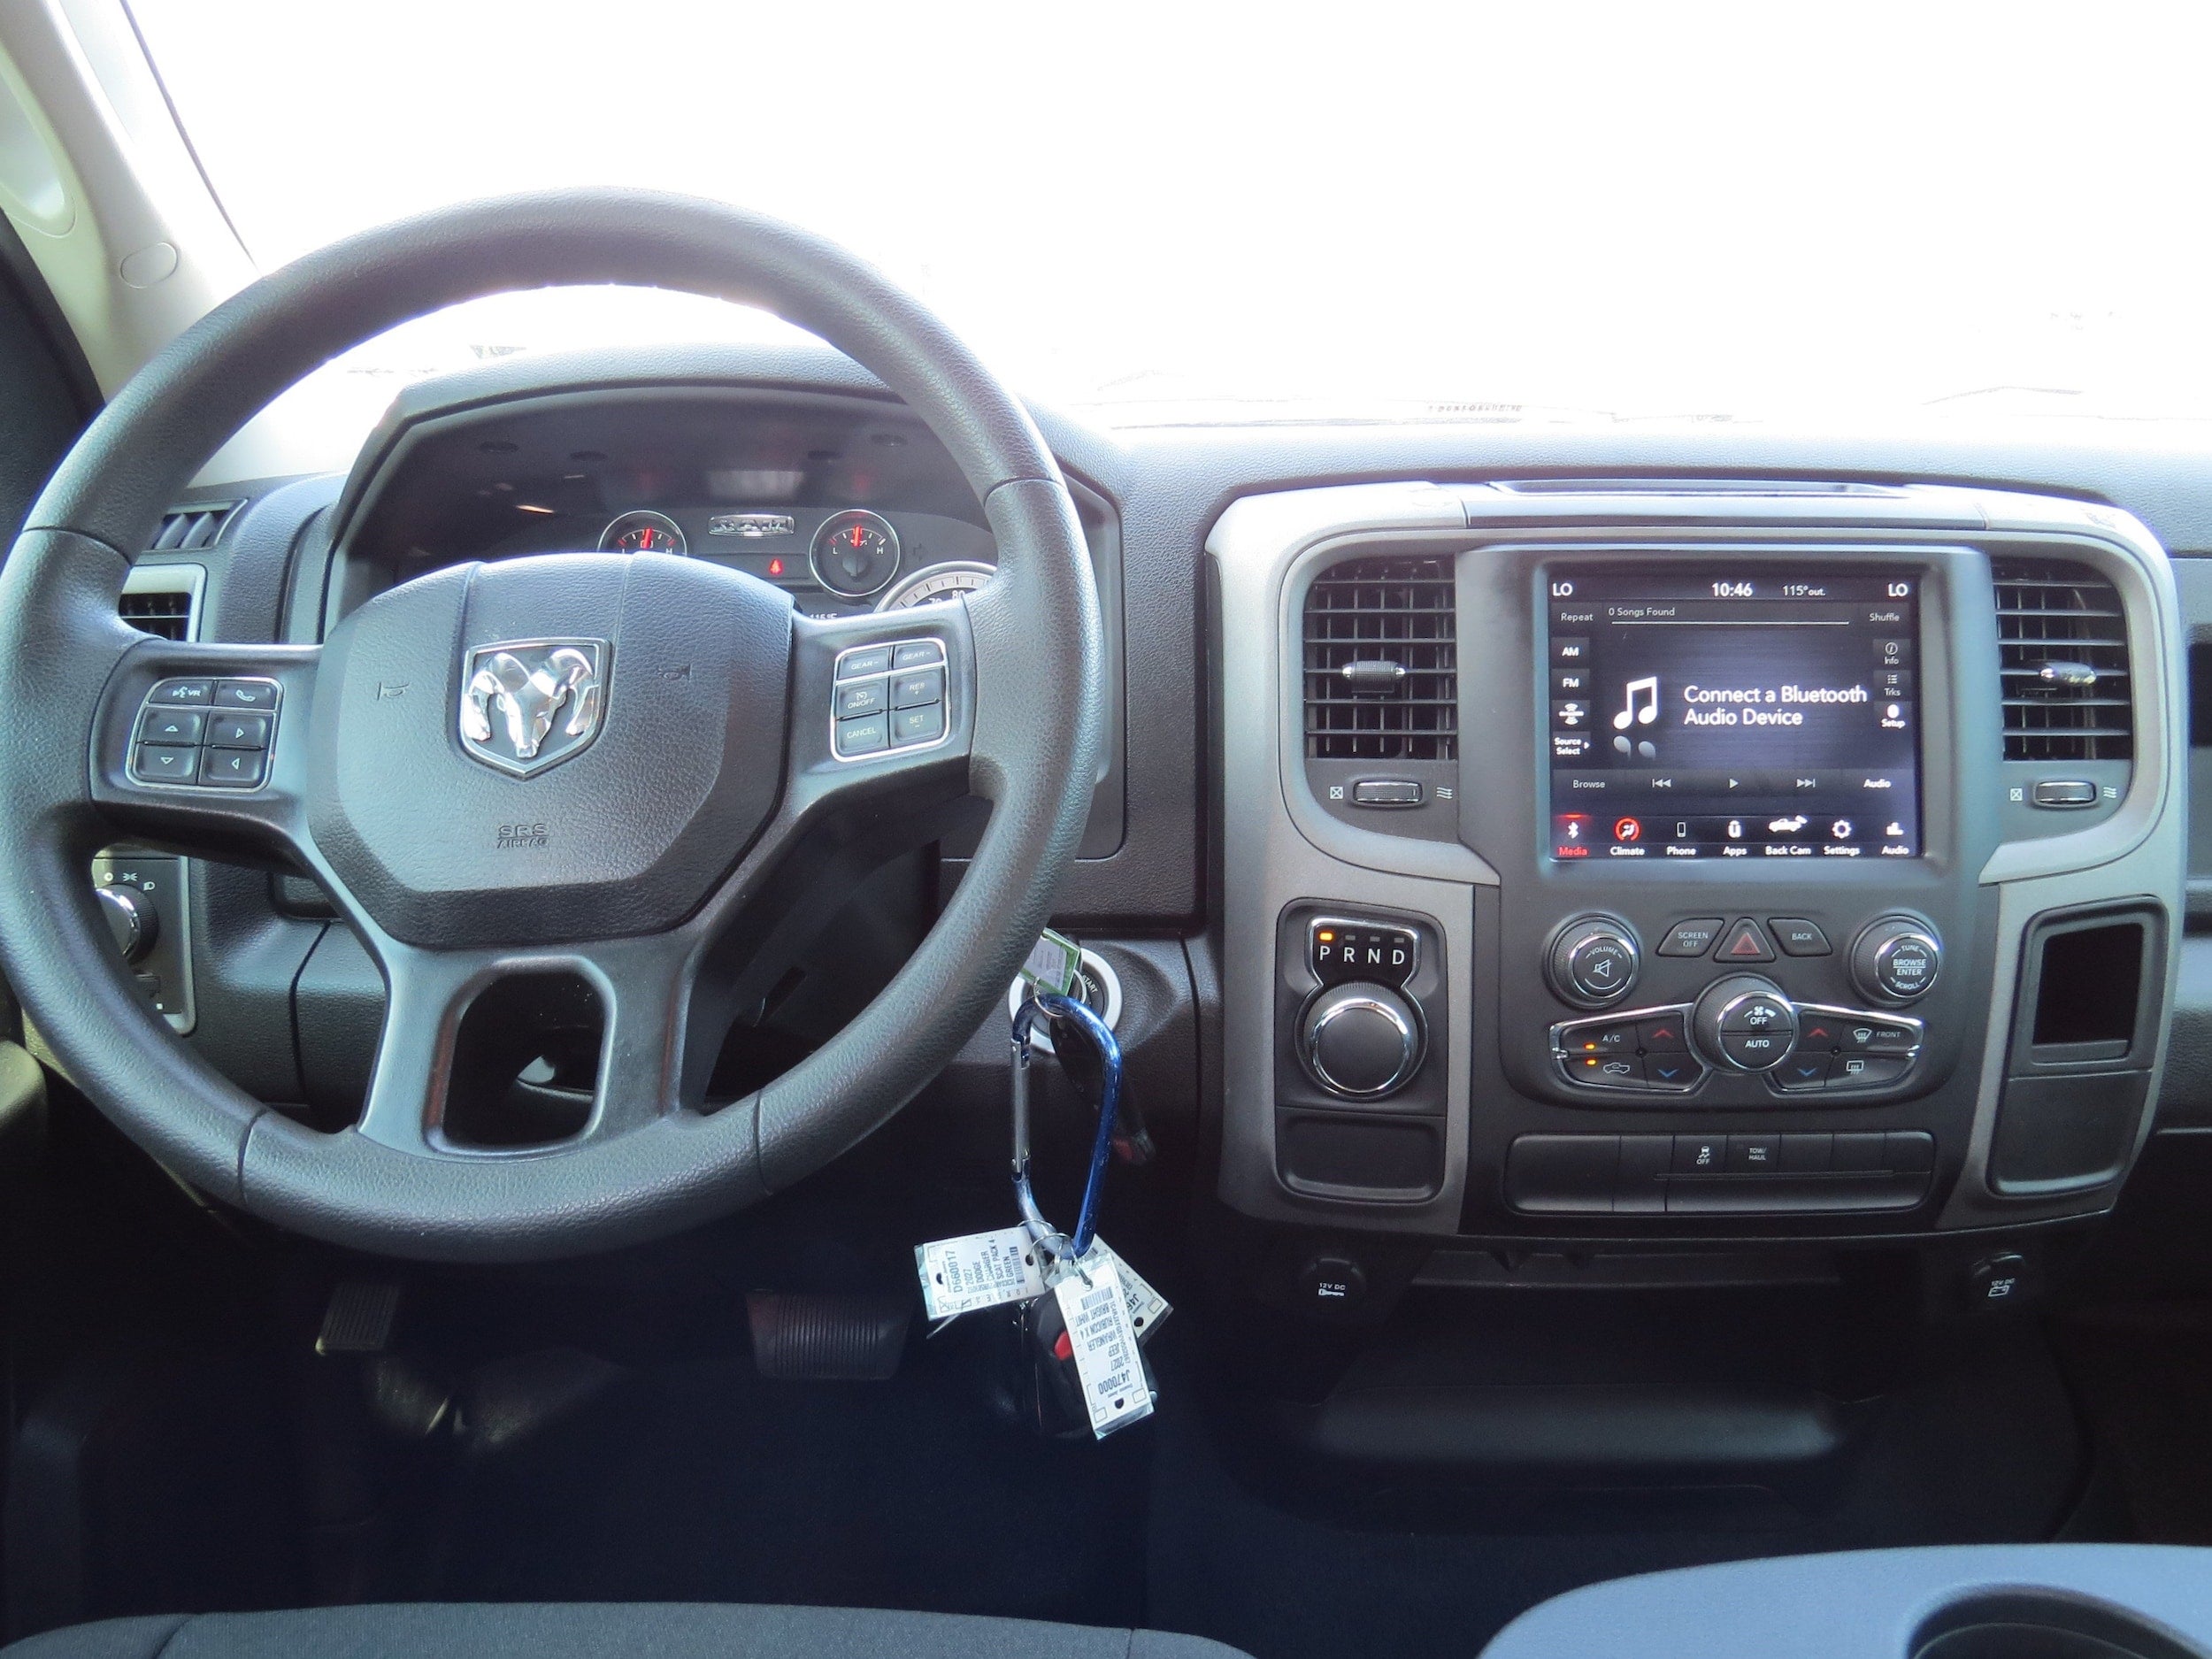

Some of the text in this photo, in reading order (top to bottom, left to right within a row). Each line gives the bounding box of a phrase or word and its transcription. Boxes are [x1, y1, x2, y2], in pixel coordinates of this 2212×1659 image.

[1552, 582, 1573, 596] LO
[1711, 582, 1754, 597] 10:46
[1887, 583, 1909, 597] LO
[1561, 612, 1594, 623] Repeat
[1617, 607, 1644, 618] Songs
[1647, 607, 1675, 616] Found
[1869, 612, 1900, 622] Shuffle
[1562, 647, 1579, 657] AM
[1884, 656, 1900, 664] Info
[909, 682, 926, 692] RES
[1563, 678, 1579, 687] FM
[1684, 684, 1867, 703] Connect a Bluetooth
[1884, 687, 1901, 696] Trks
[847, 697, 875, 710] ON/OFF
[909, 714, 924, 725] SET
[1684, 708, 1803, 726] Audio Device
[1880, 718, 1906, 729] Setup
[847, 727, 877, 740] CANCEL
[1554, 737, 1582, 746] Source
[1555, 747, 1581, 756] Select
[1572, 780, 1606, 788] Browse
[1863, 779, 1892, 788] Audio
[498, 823, 549, 838] SRS
[1559, 847, 1588, 856] Media
[1609, 846, 1646, 856] Climate
[1666, 846, 1697, 856] Phone
[1722, 846, 1747, 857] Apps
[1765, 846, 1811, 856] Back Cam
[1824, 846, 1860, 857] Settings
[1881, 845, 1909, 856] Audio
[1791, 932, 1812, 941] BACK
[1319, 946, 1405, 965] P R N D
[1589, 946, 1618, 956] VOLUME
[1895, 981, 1921, 990] SCROLL
[1749, 1016, 1768, 1025] OFF
[1602, 1033, 1621, 1043] A/C
[1876, 1030, 1901, 1039] FRONT
[1745, 1039, 1770, 1048] AUTO
[989, 1245, 1001, 1262] PACK
[945, 1250, 964, 1293] D660017
[972, 1261, 985, 1283] DODGE
[1002, 1256, 1014, 1278] GREEN
[1087, 1329, 1117, 1352] WRANGLER
[1097, 1369, 1131, 1394] J470000
